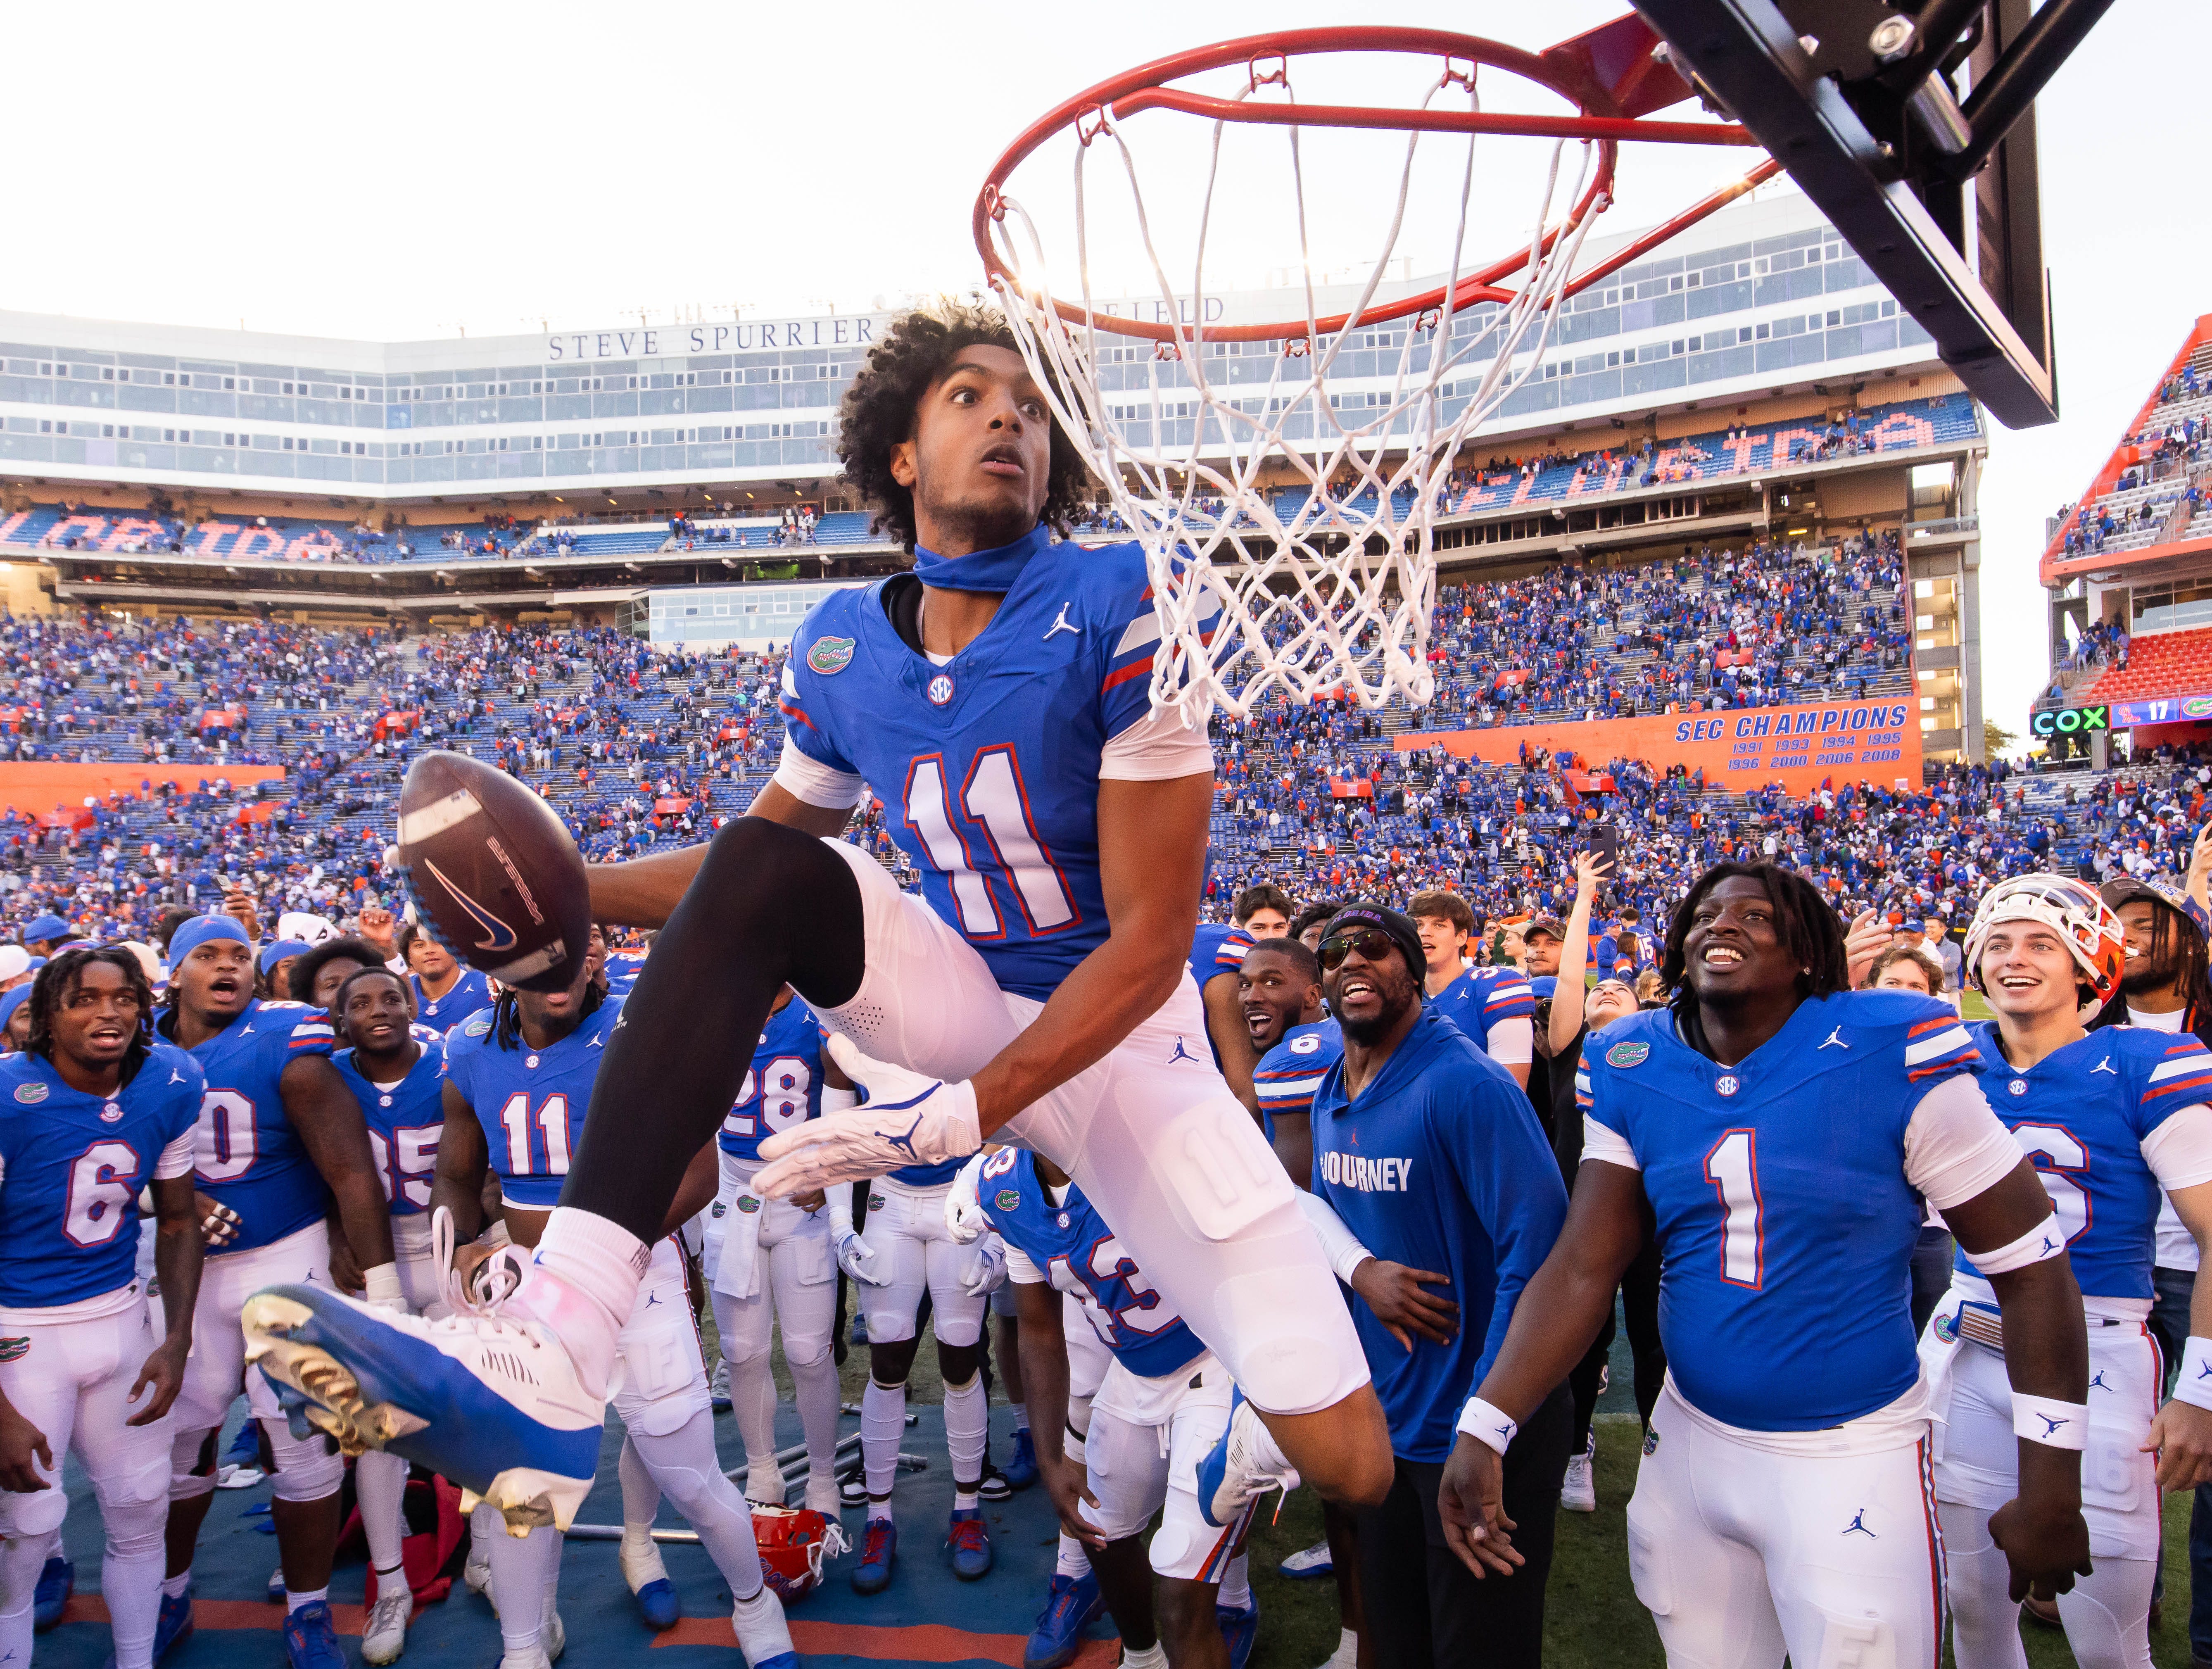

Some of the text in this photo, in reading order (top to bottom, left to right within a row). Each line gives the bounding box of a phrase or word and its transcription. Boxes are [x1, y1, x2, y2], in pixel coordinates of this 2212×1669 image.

[549, 297, 1224, 360] STEVE SPURRIER FIELD
[929, 679, 952, 704] SEC
[1675, 704, 1908, 743] SEC CHAMPIONS
[2034, 706, 2106, 734] COX
[2148, 700, 2168, 721] 17
[1732, 732, 1903, 754] 1991 1993 1994 1995
[1728, 749, 1901, 771] 1996 2000 2006 2008
[903, 742, 1083, 941] 11
[1638, 936, 1654, 961] 15
[723, 1056, 811, 1138] 28
[1717, 1076, 1738, 1095] SEC
[2009, 1080, 2027, 1096] SEC
[500, 1092, 573, 1175] 11
[1322, 1151, 1413, 1192] JOURNEY
[62, 1140, 140, 1248] 6
[1057, 1213, 1070, 1229] SEC
[1703, 1128, 1764, 1291] 1
